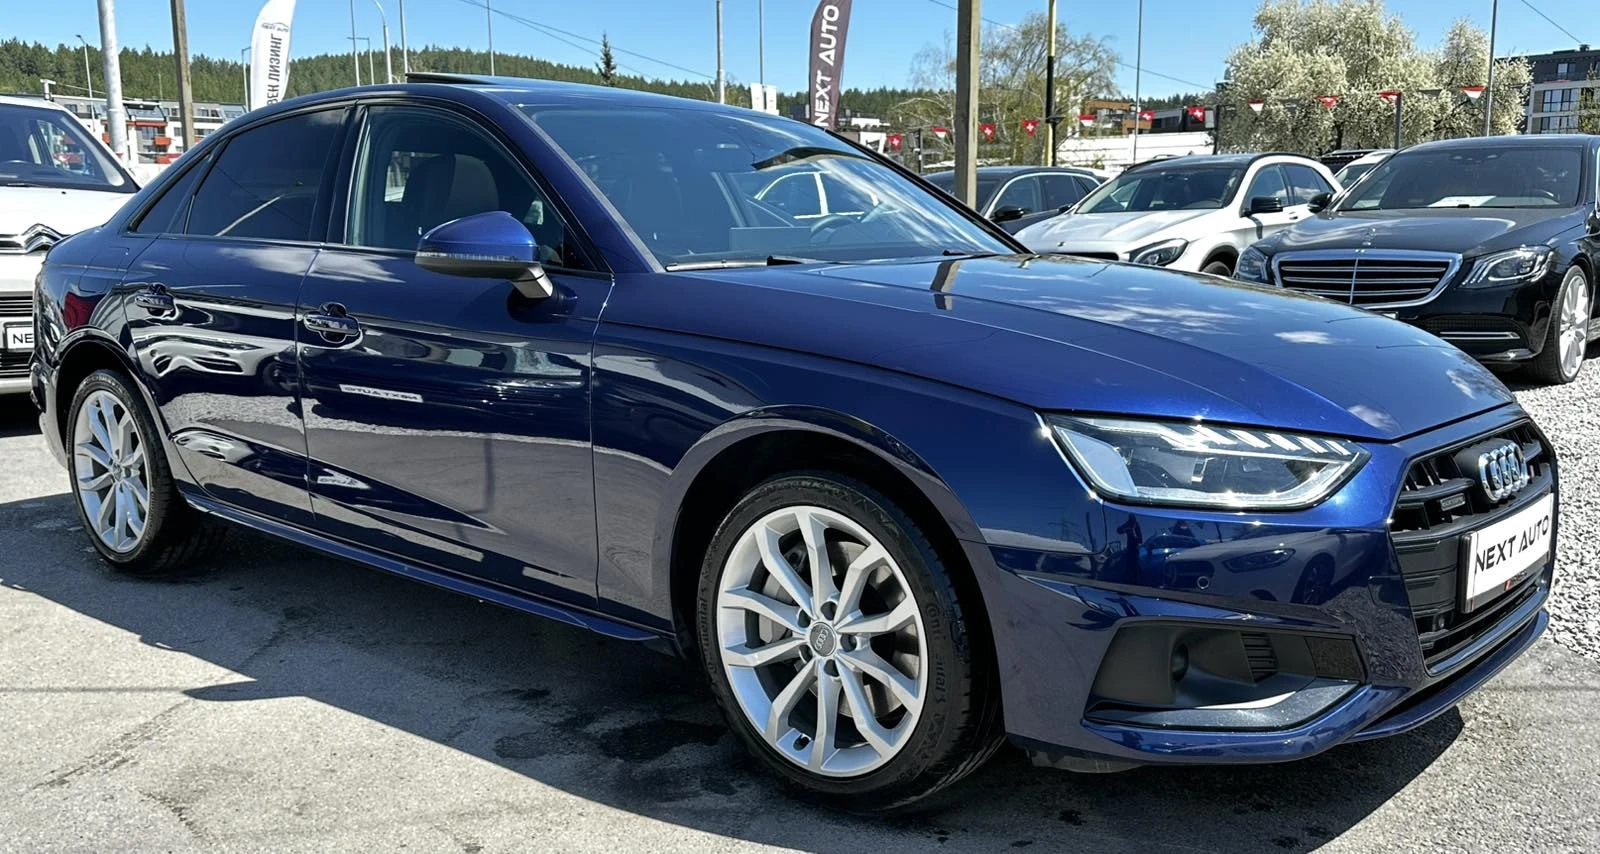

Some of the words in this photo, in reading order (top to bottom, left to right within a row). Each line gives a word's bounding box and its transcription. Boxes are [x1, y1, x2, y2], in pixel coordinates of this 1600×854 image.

[268, 33, 282, 82] ЛИЗИНГ
[818, 4, 839, 67] AUTO
[814, 69, 832, 127] NEXT
[1475, 535, 1517, 574] NEXT
[1519, 515, 1549, 553] AUTO
